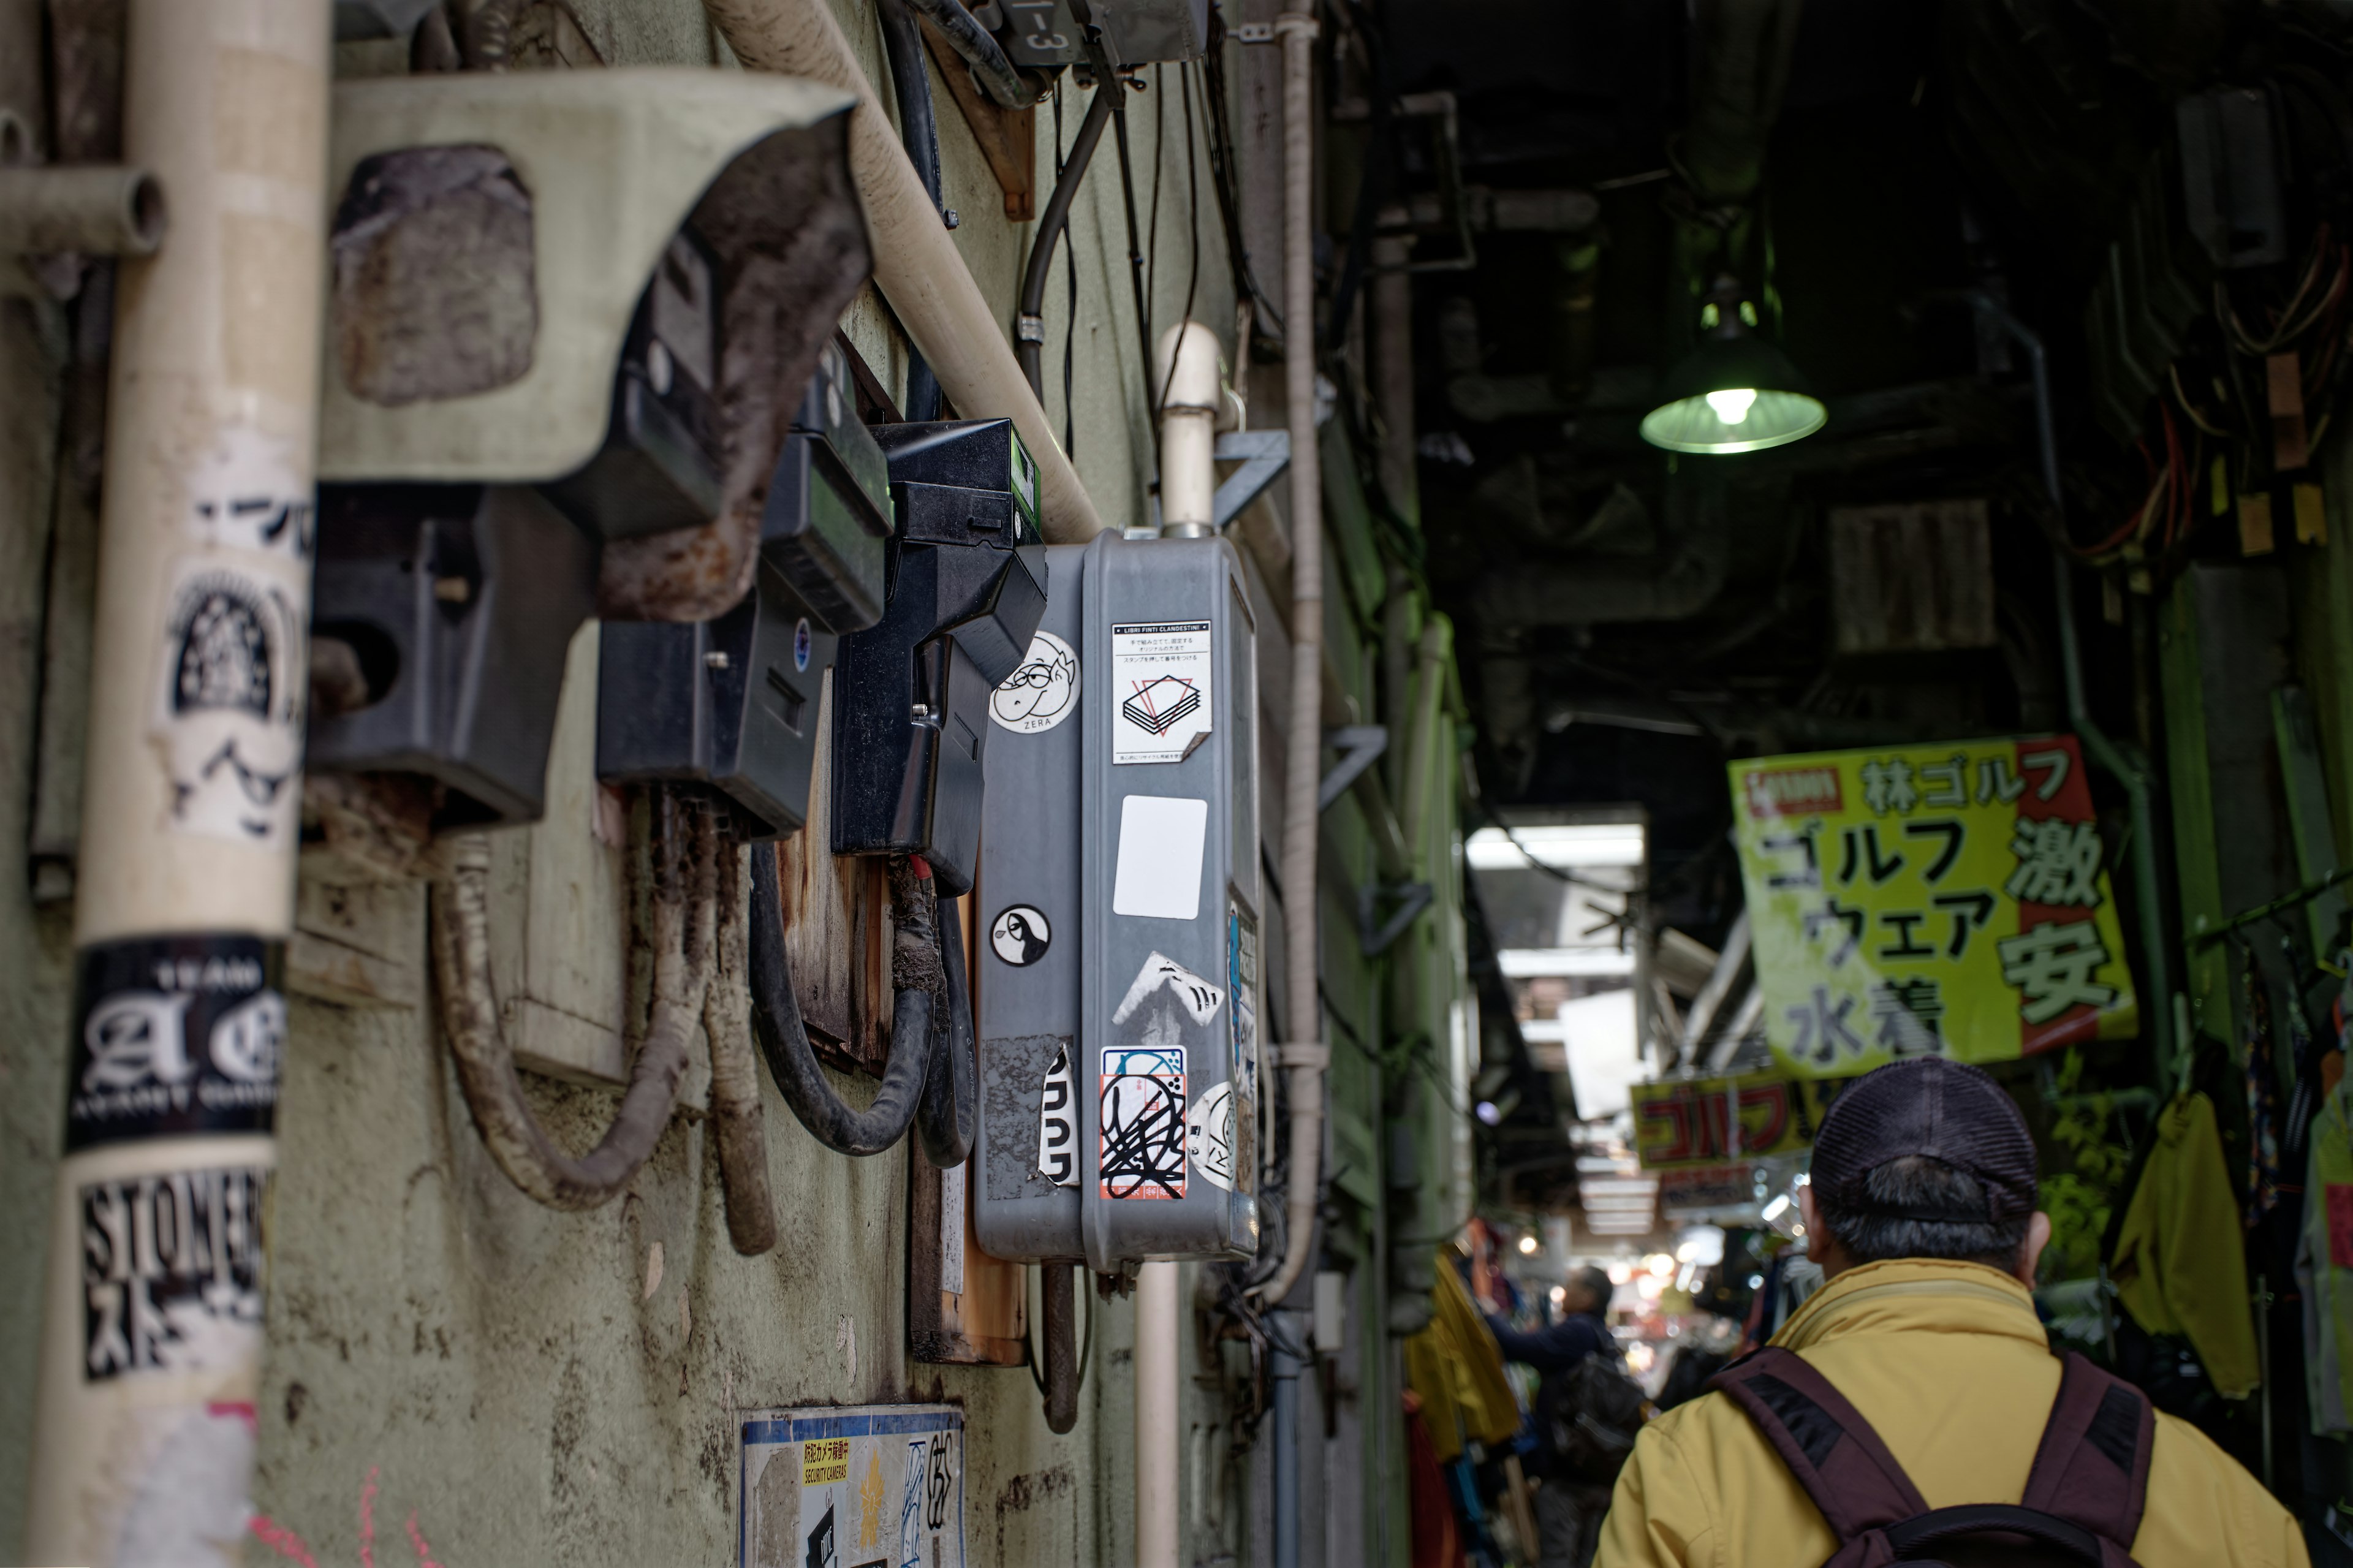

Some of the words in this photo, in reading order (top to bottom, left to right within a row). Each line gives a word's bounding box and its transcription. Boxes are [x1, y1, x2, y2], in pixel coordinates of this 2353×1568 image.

[1025, 718, 1051, 730] ZERA
[1860, 748, 2070, 817] 林ゴルフ
[1762, 816, 1966, 890] ゴルフ
[1998, 816, 2120, 1026] 激安
[804, 1439, 849, 1464] 防犯カメラ稼働中
[805, 1467, 827, 1484] SECURITY
[827, 1464, 847, 1481] CAMERAS
